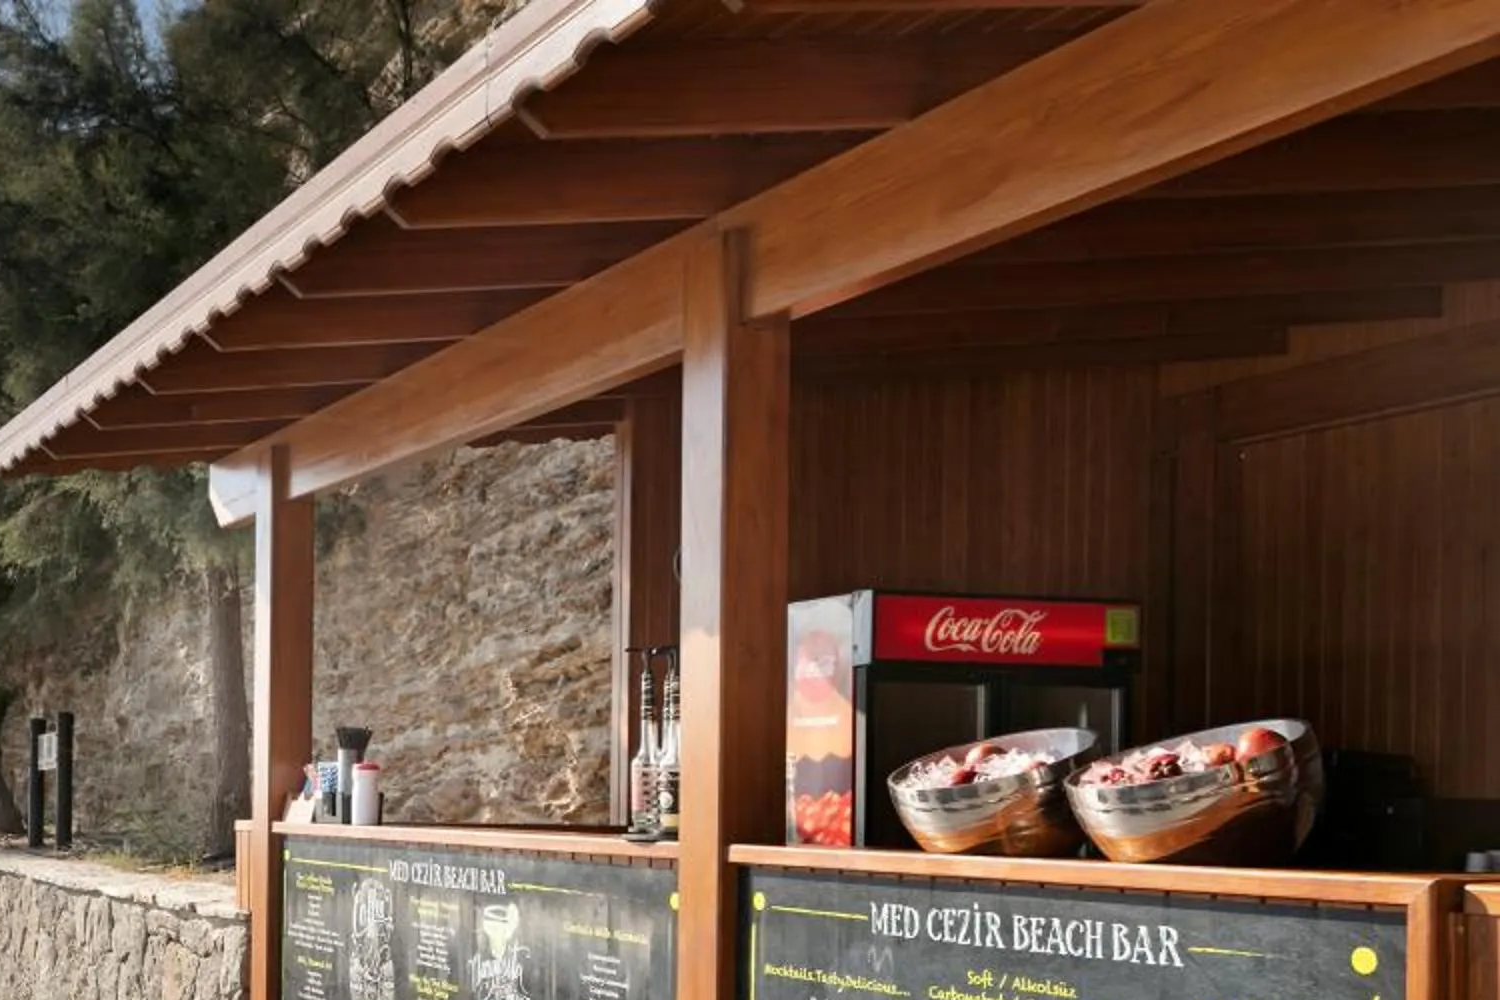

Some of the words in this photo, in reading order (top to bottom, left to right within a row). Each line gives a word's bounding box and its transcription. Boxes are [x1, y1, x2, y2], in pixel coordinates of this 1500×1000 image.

[924, 606, 1047, 655] Coca-Cola
[389, 859, 409, 883] MED
[443, 864, 479, 891] BEACH
[480, 868, 506, 895] BAR
[870, 902, 920, 939] MED
[927, 903, 1005, 949] CEZİR
[1012, 914, 1103, 960] BEACH
[1112, 923, 1184, 967] BAR
[967, 969, 993, 988] Soft
